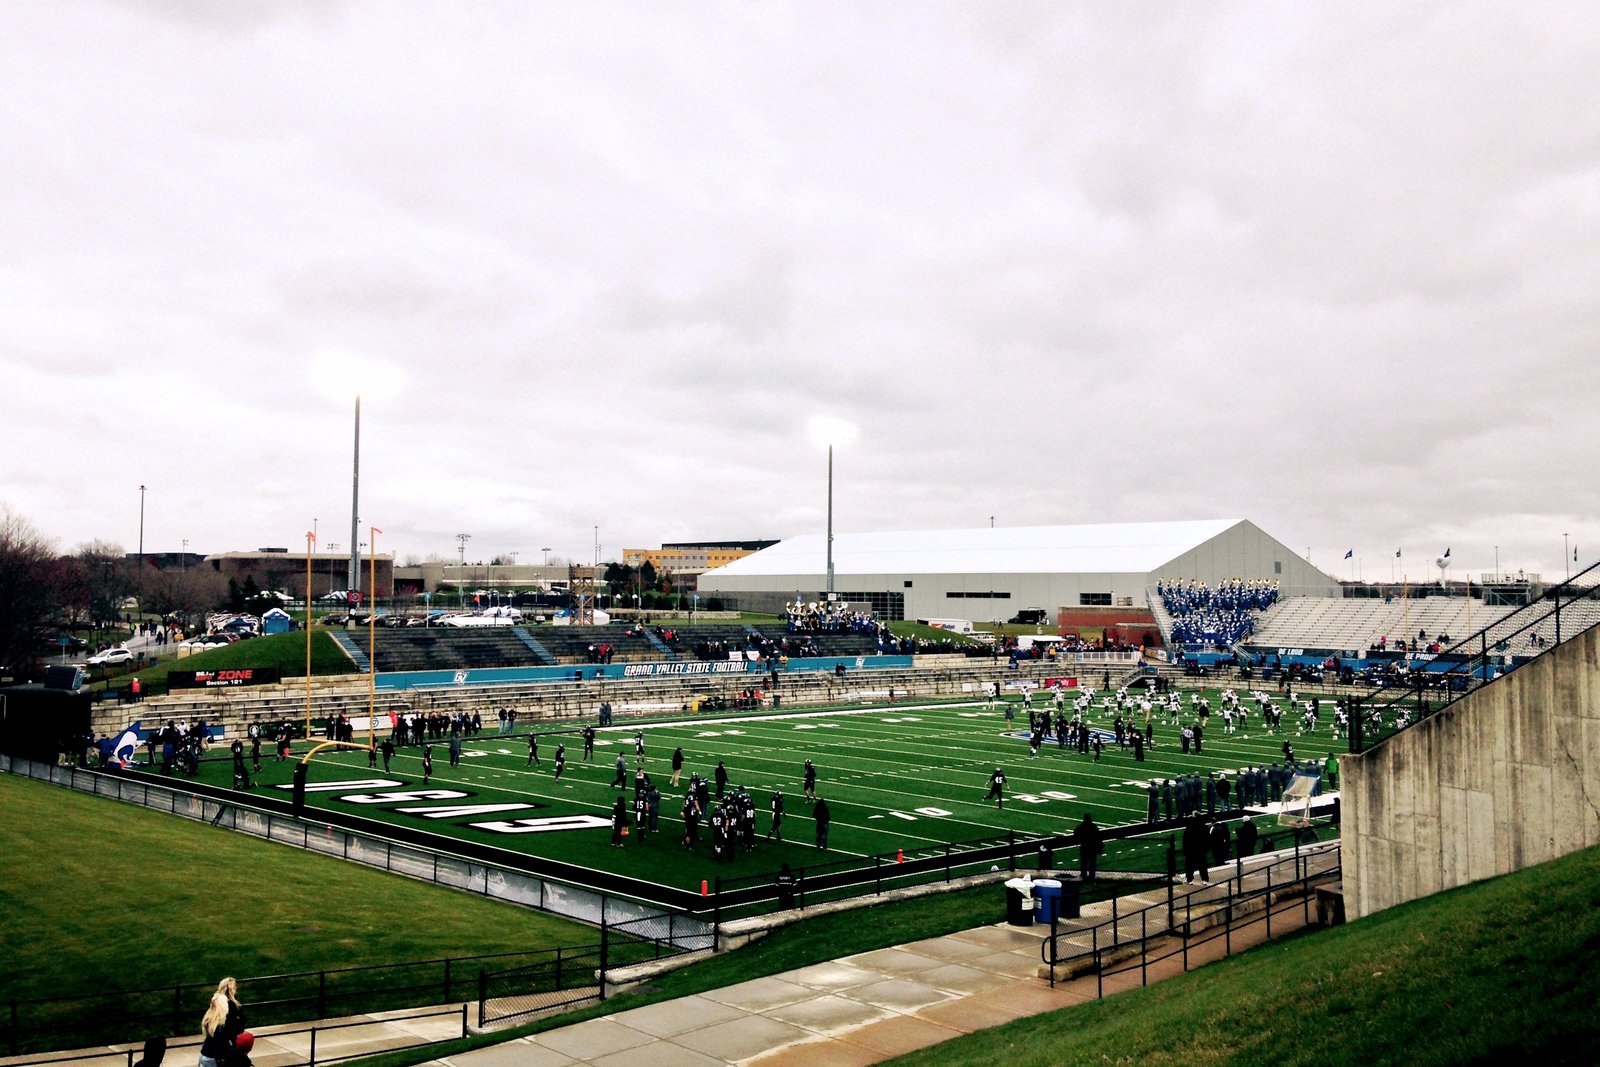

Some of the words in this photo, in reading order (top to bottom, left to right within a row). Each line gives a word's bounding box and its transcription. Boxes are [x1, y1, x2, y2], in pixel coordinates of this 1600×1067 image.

[624, 666, 652, 676] GRAND
[656, 664, 684, 674] VALLEY
[686, 663, 710, 673] STATE
[712, 661, 748, 671] FOOTBALL
[218, 670, 253, 679] ZONE
[455, 671, 469, 684] GV
[636, 800, 644, 809] 15
